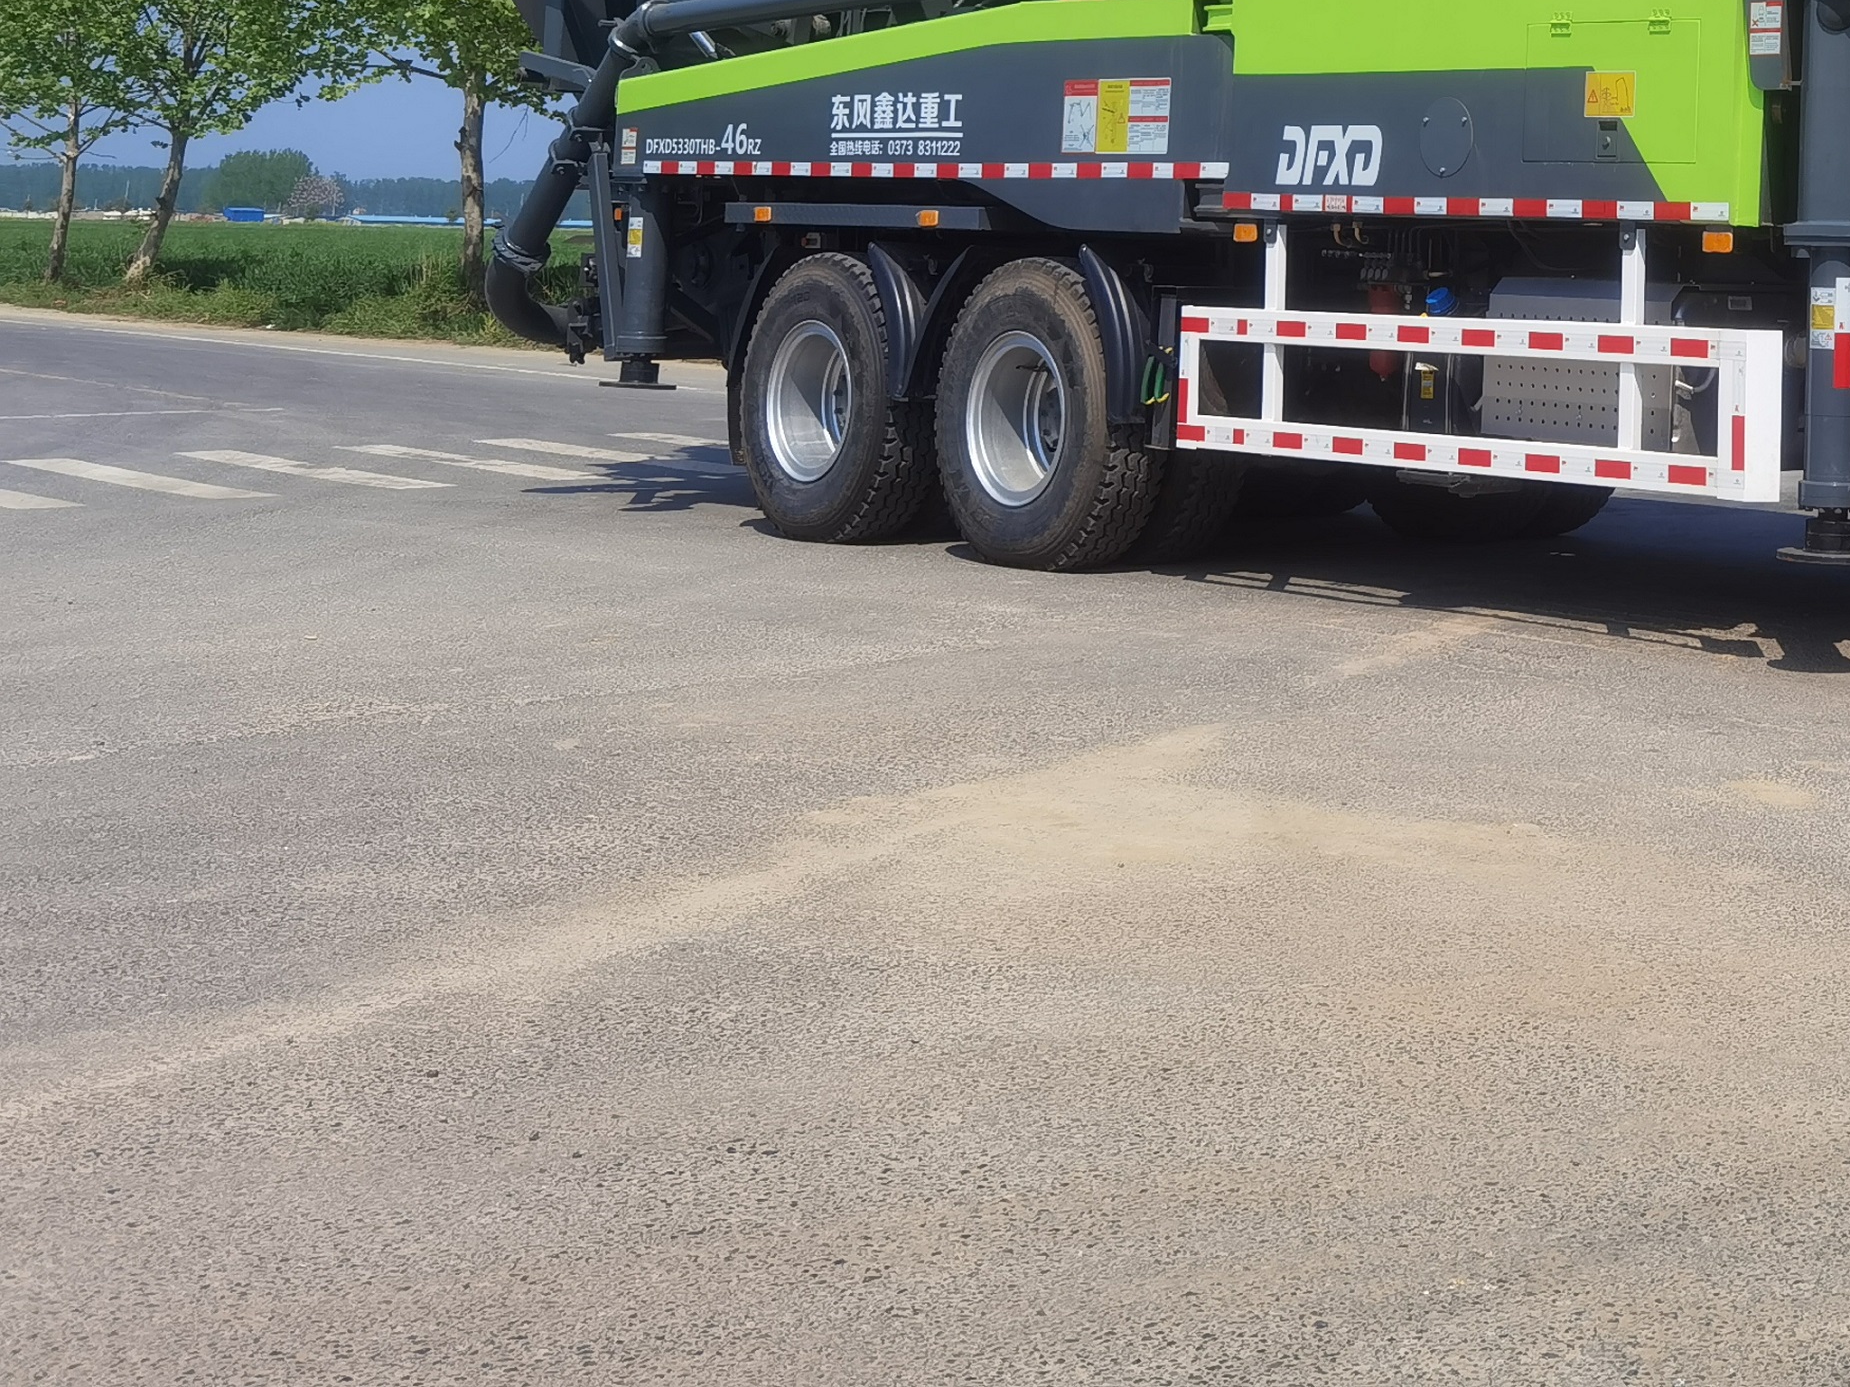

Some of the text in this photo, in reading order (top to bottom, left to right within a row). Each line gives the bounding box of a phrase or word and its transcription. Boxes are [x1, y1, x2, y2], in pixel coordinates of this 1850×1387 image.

[830, 92, 963, 130] 东风鑫达重工
[645, 123, 762, 155] DFXD5330THB-46RZ
[887, 140, 914, 156] 0373
[917, 140, 961, 156] 8311222
[1275, 125, 1383, 186] DFXD
